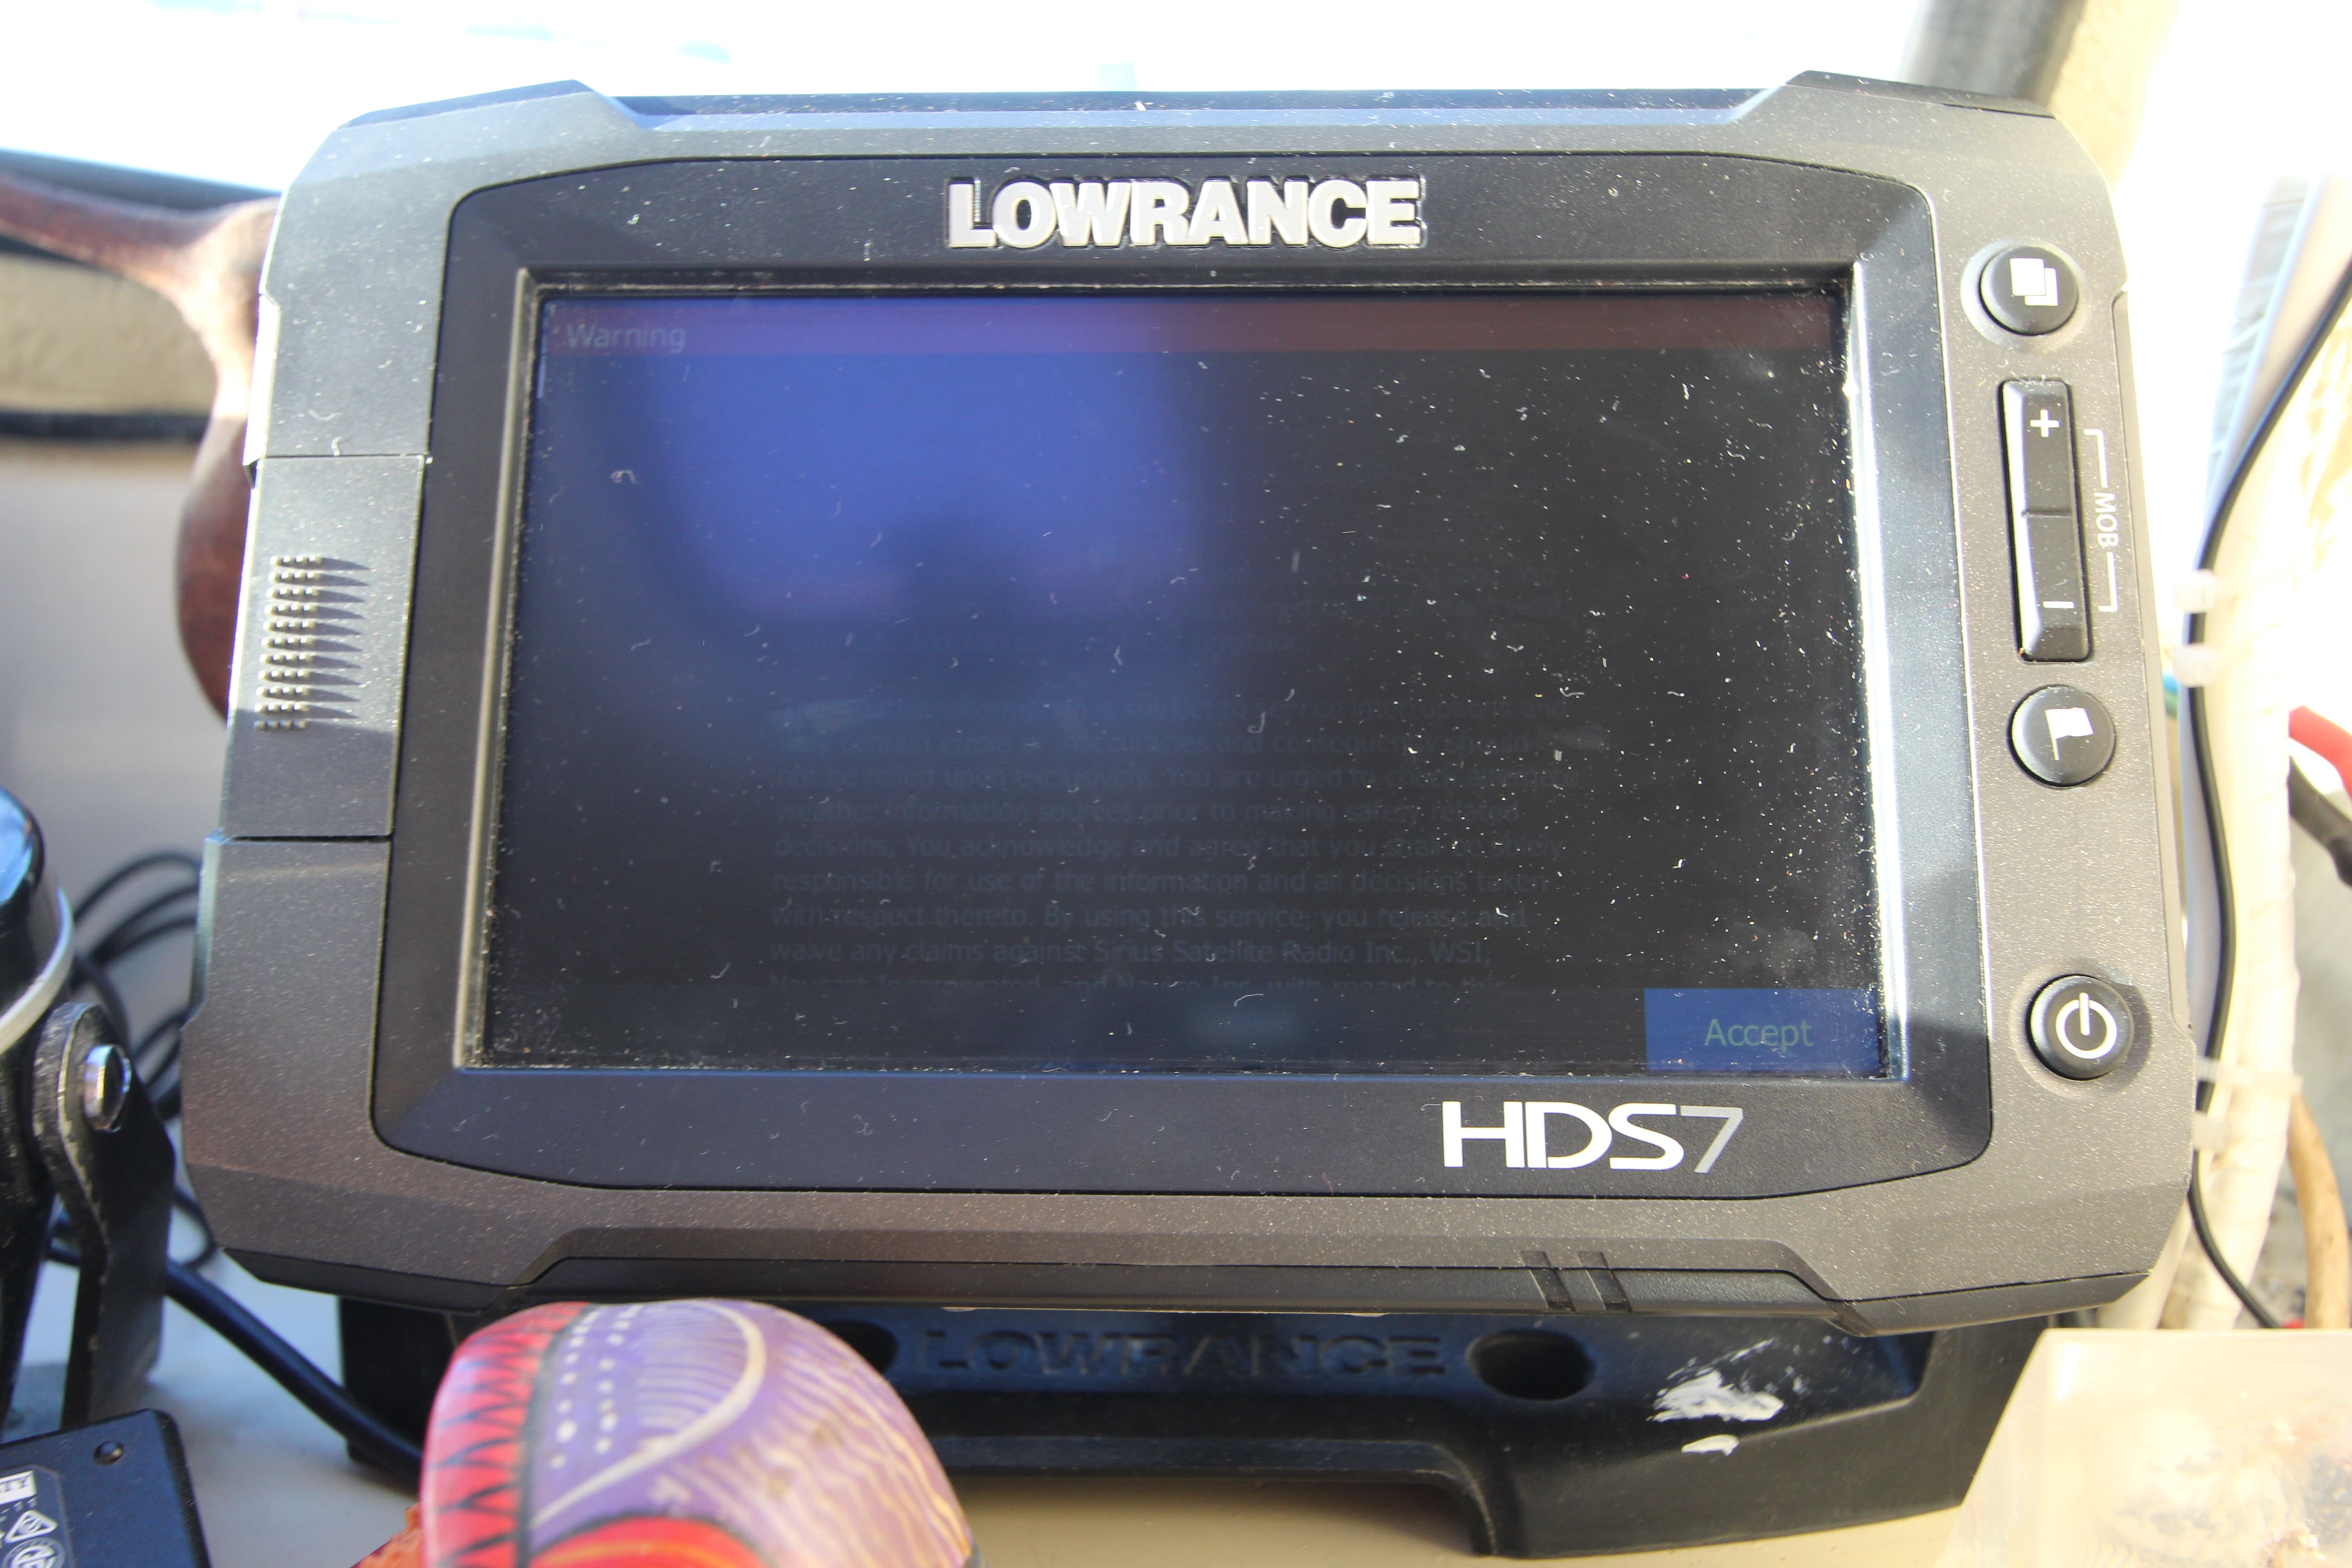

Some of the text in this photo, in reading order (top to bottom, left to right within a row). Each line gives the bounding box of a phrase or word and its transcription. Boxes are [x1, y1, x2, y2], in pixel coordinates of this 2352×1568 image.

[946, 176, 1426, 248] LOWRANCE
[566, 323, 686, 354] Warning
[2093, 492, 2119, 548] MOB
[906, 836, 951, 857] You
[1133, 833, 1181, 857] and
[773, 867, 914, 895] responsible
[924, 867, 959, 891] for
[968, 872, 1013, 892] use
[1019, 867, 1046, 891] of
[1054, 868, 1096, 891] the
[1102, 867, 1249, 892] information
[1258, 867, 1306, 892] and
[771, 903, 823, 926] with
[834, 906, 926, 931] respect
[935, 903, 1033, 926] thereto.
[1044, 906, 1075, 931] By
[1084, 905, 1151, 932] using
[1321, 908, 1368, 932] you
[1377, 904, 1469, 927] release
[1476, 904, 1527, 927] and
[769, 939, 842, 961] waive
[850, 944, 899, 966] any
[906, 939, 985, 962] claims
[993, 940, 1084, 966] against
[1093, 939, 1165, 963] Sirius
[1172, 938, 1274, 963] Satellite
[1282, 938, 1355, 963] Radio
[1704, 1018, 1814, 1053] Accept
[1442, 1100, 1744, 1173] HDS7
[917, 1328, 1447, 1377] LOWRANCE
